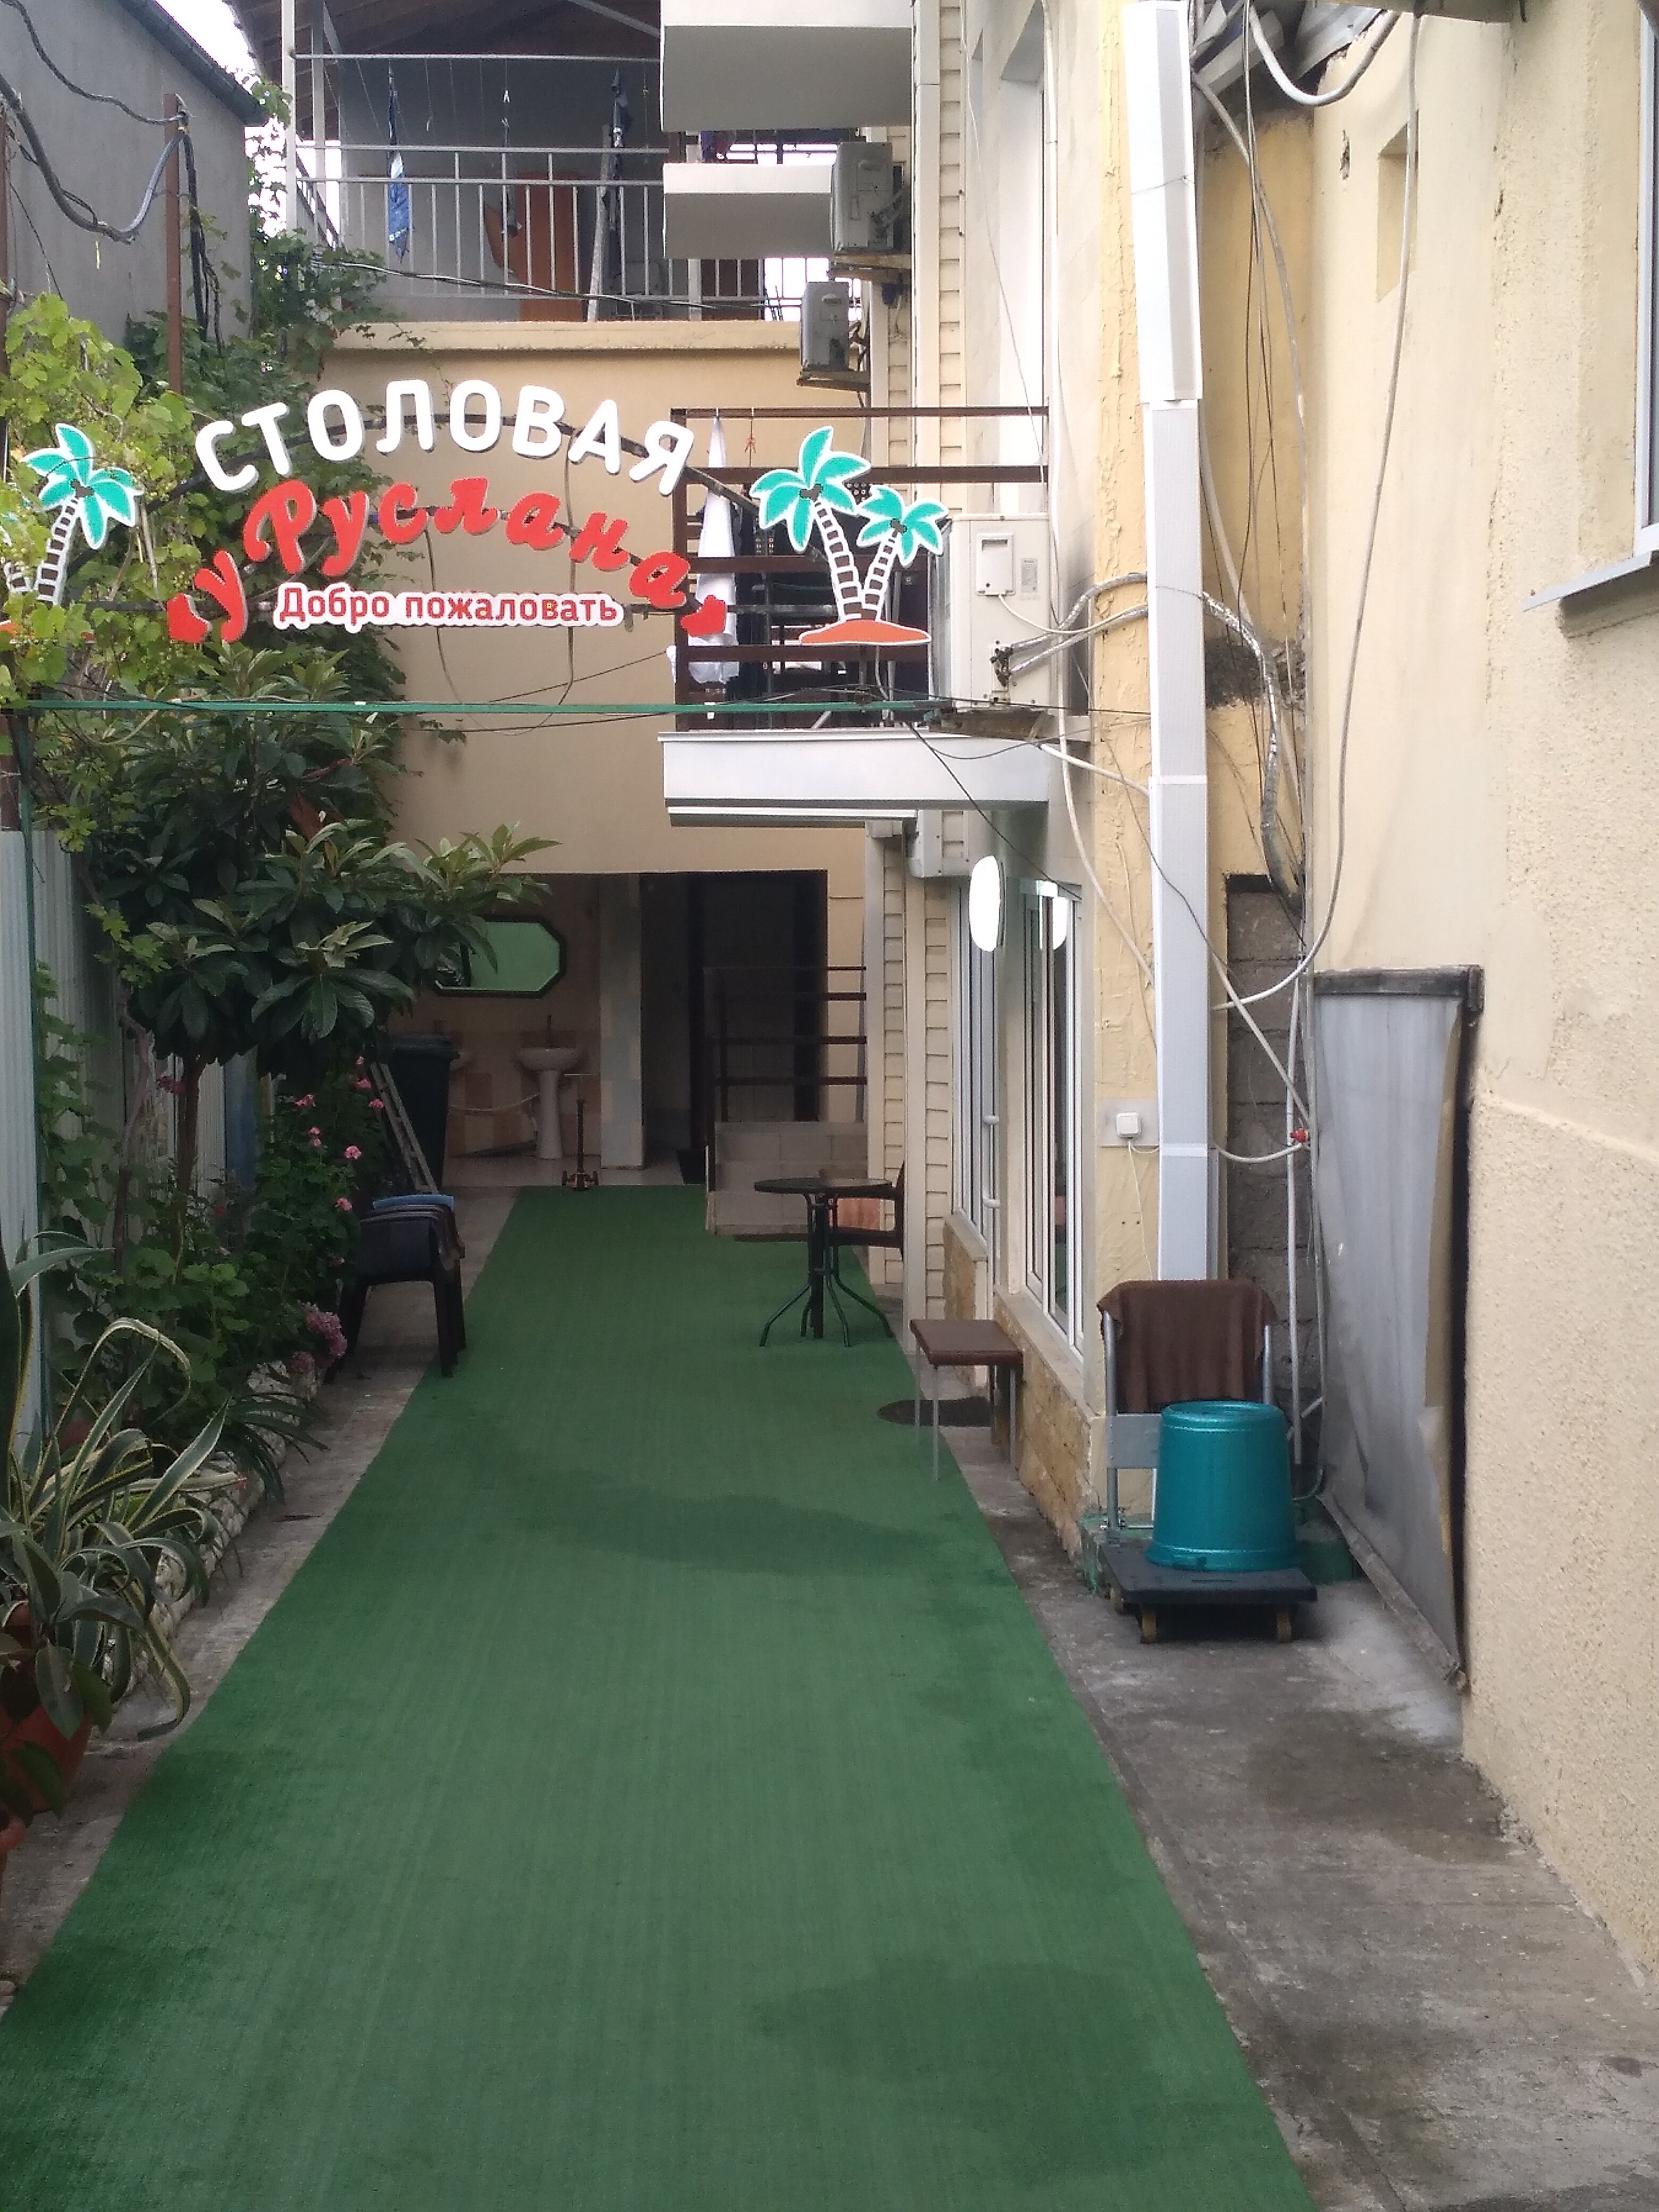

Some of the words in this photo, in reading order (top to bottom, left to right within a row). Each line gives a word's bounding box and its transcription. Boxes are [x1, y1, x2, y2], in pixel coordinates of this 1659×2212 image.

[195, 380, 694, 496] СТОЛОВАЯ
[243, 477, 691, 608] Руслана
[280, 587, 389, 626] Добро
[406, 594, 617, 621] пожаловать
